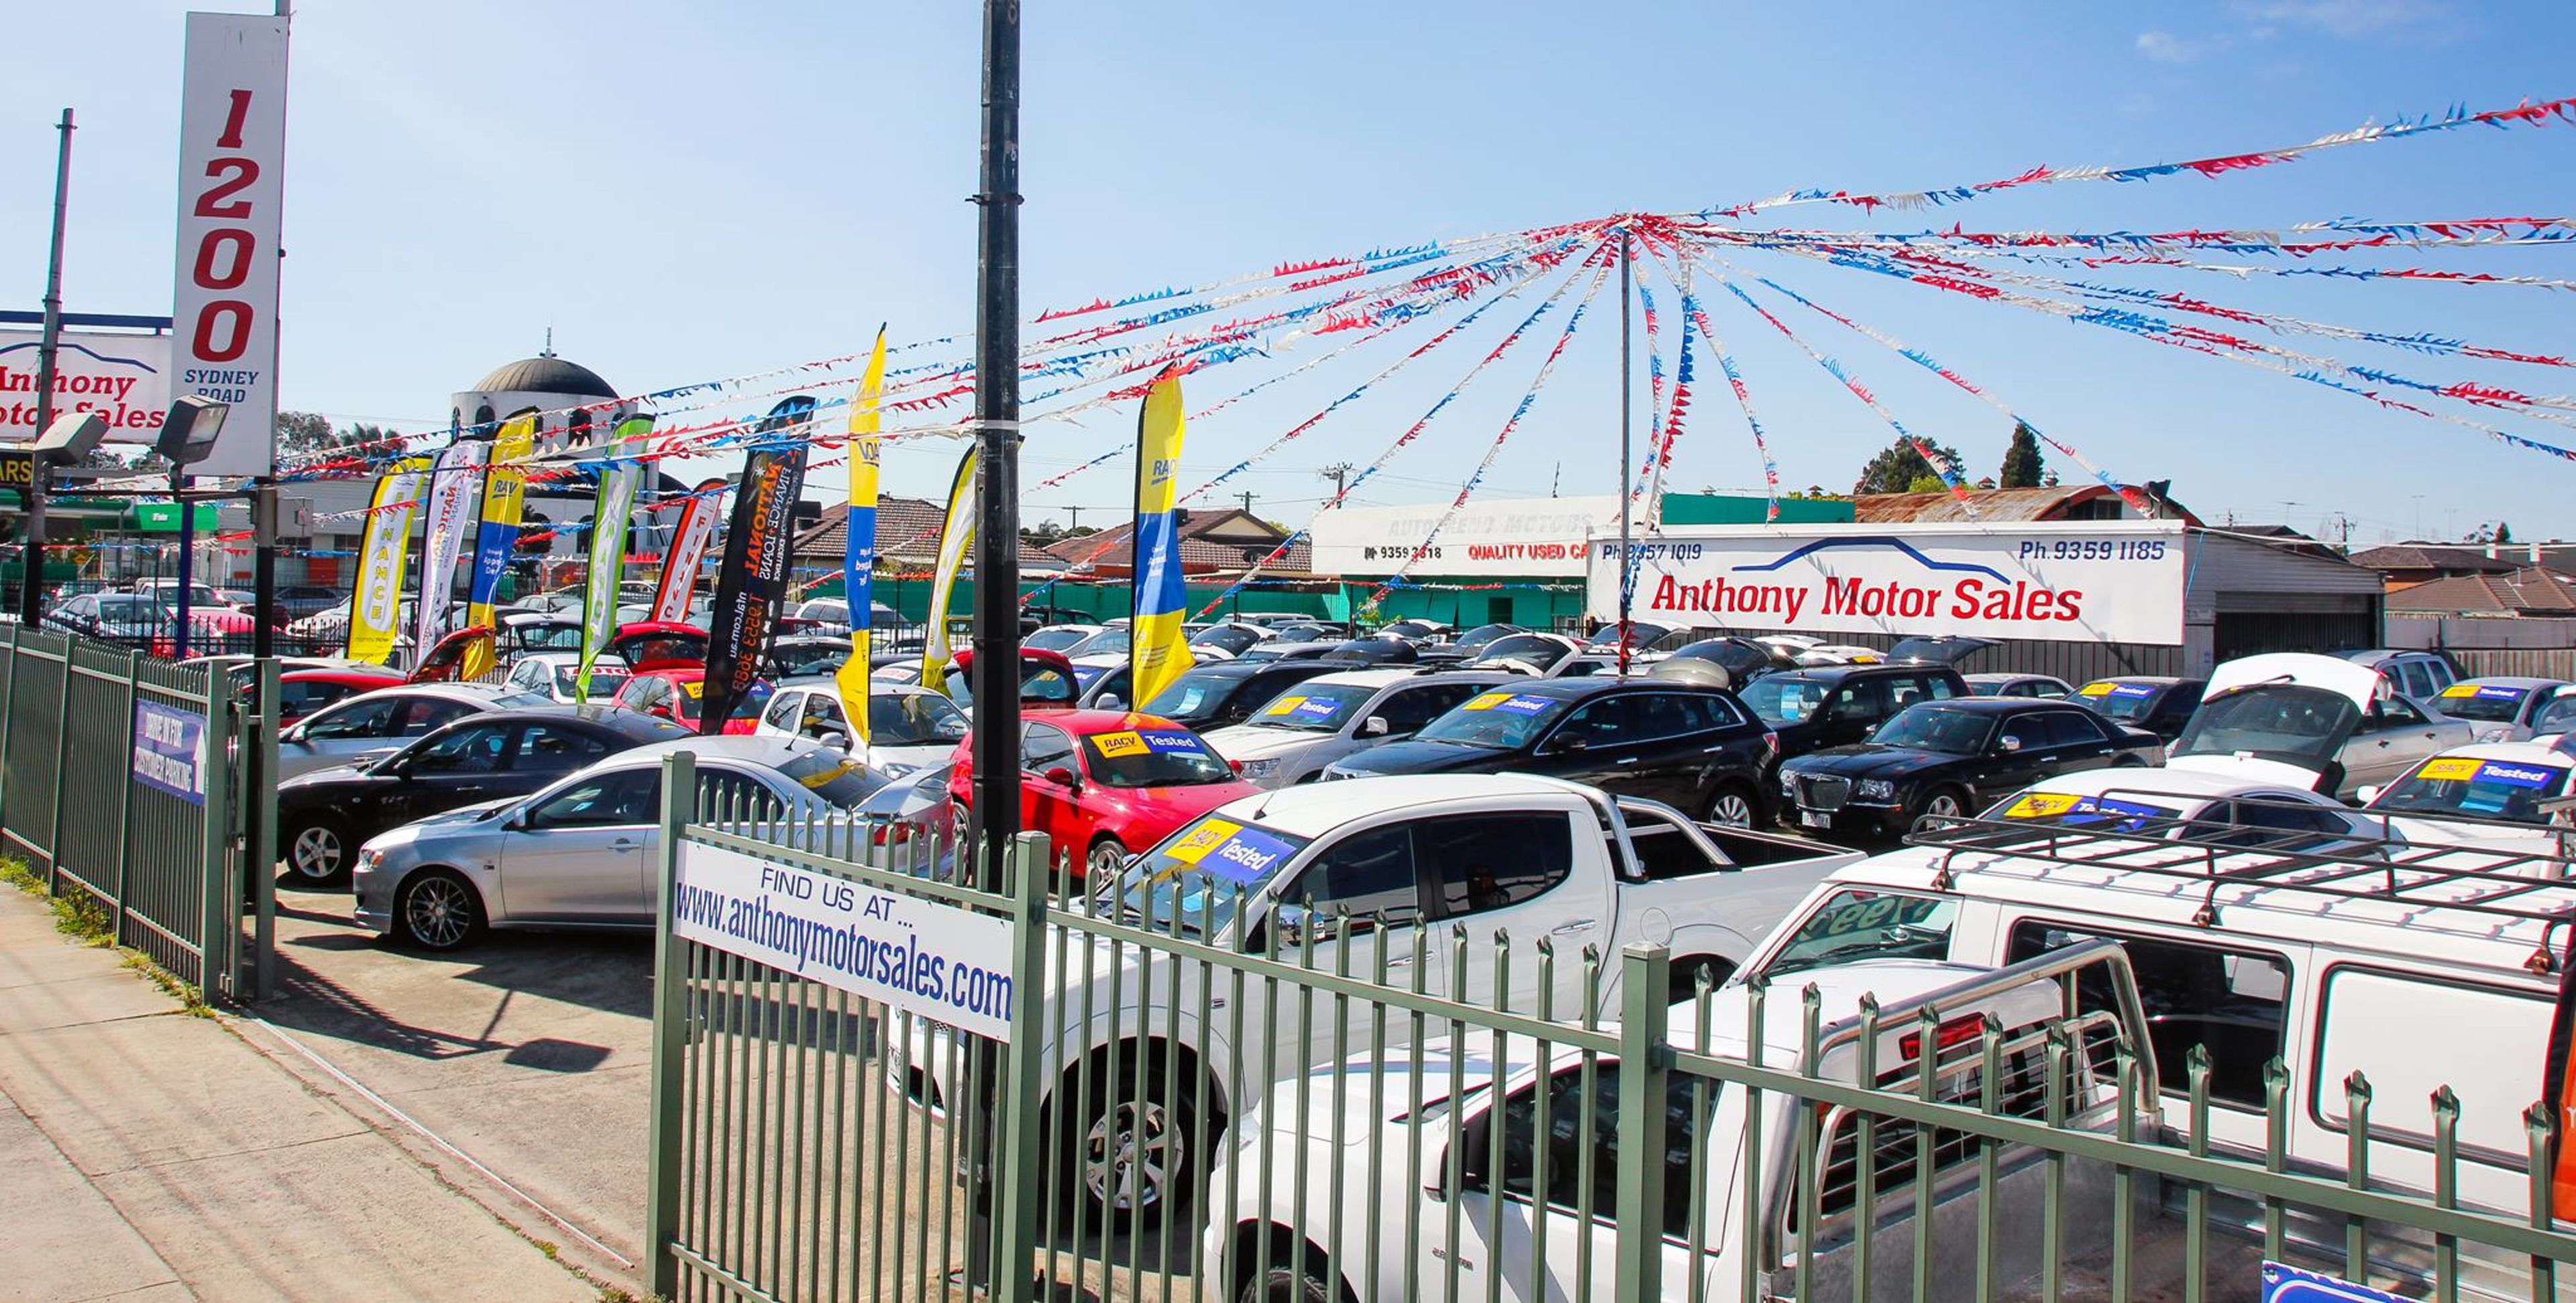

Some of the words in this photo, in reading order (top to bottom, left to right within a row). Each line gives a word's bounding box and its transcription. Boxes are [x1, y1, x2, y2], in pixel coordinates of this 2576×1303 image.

[0, 366, 137, 402] nhony
[184, 370, 260, 384] SYDNEY
[370, 492, 405, 620] FNANCE
[1381, 547, 1409, 559] 9359
[1468, 544, 1524, 561] QUALITY
[1528, 544, 1566, 561] USED
[1570, 544, 1589, 560] CA
[1670, 544, 1702, 560] 1019
[2118, 541, 2166, 561] 1185
[1651, 574, 1809, 624] Anthony
[1821, 576, 1941, 618] Motor
[1951, 578, 2083, 622] Sales
[1299, 701, 1335, 715] Tested
[1104, 736, 1136, 748] RACV
[1144, 734, 1197, 748] Tested
[2483, 764, 2547, 782] Tested
[1218, 837, 1277, 871] Tested
[761, 867, 812, 900] FIND
[822, 882, 855, 912] US
[677, 882, 1012, 1022] www.anthonymotorsales.com
